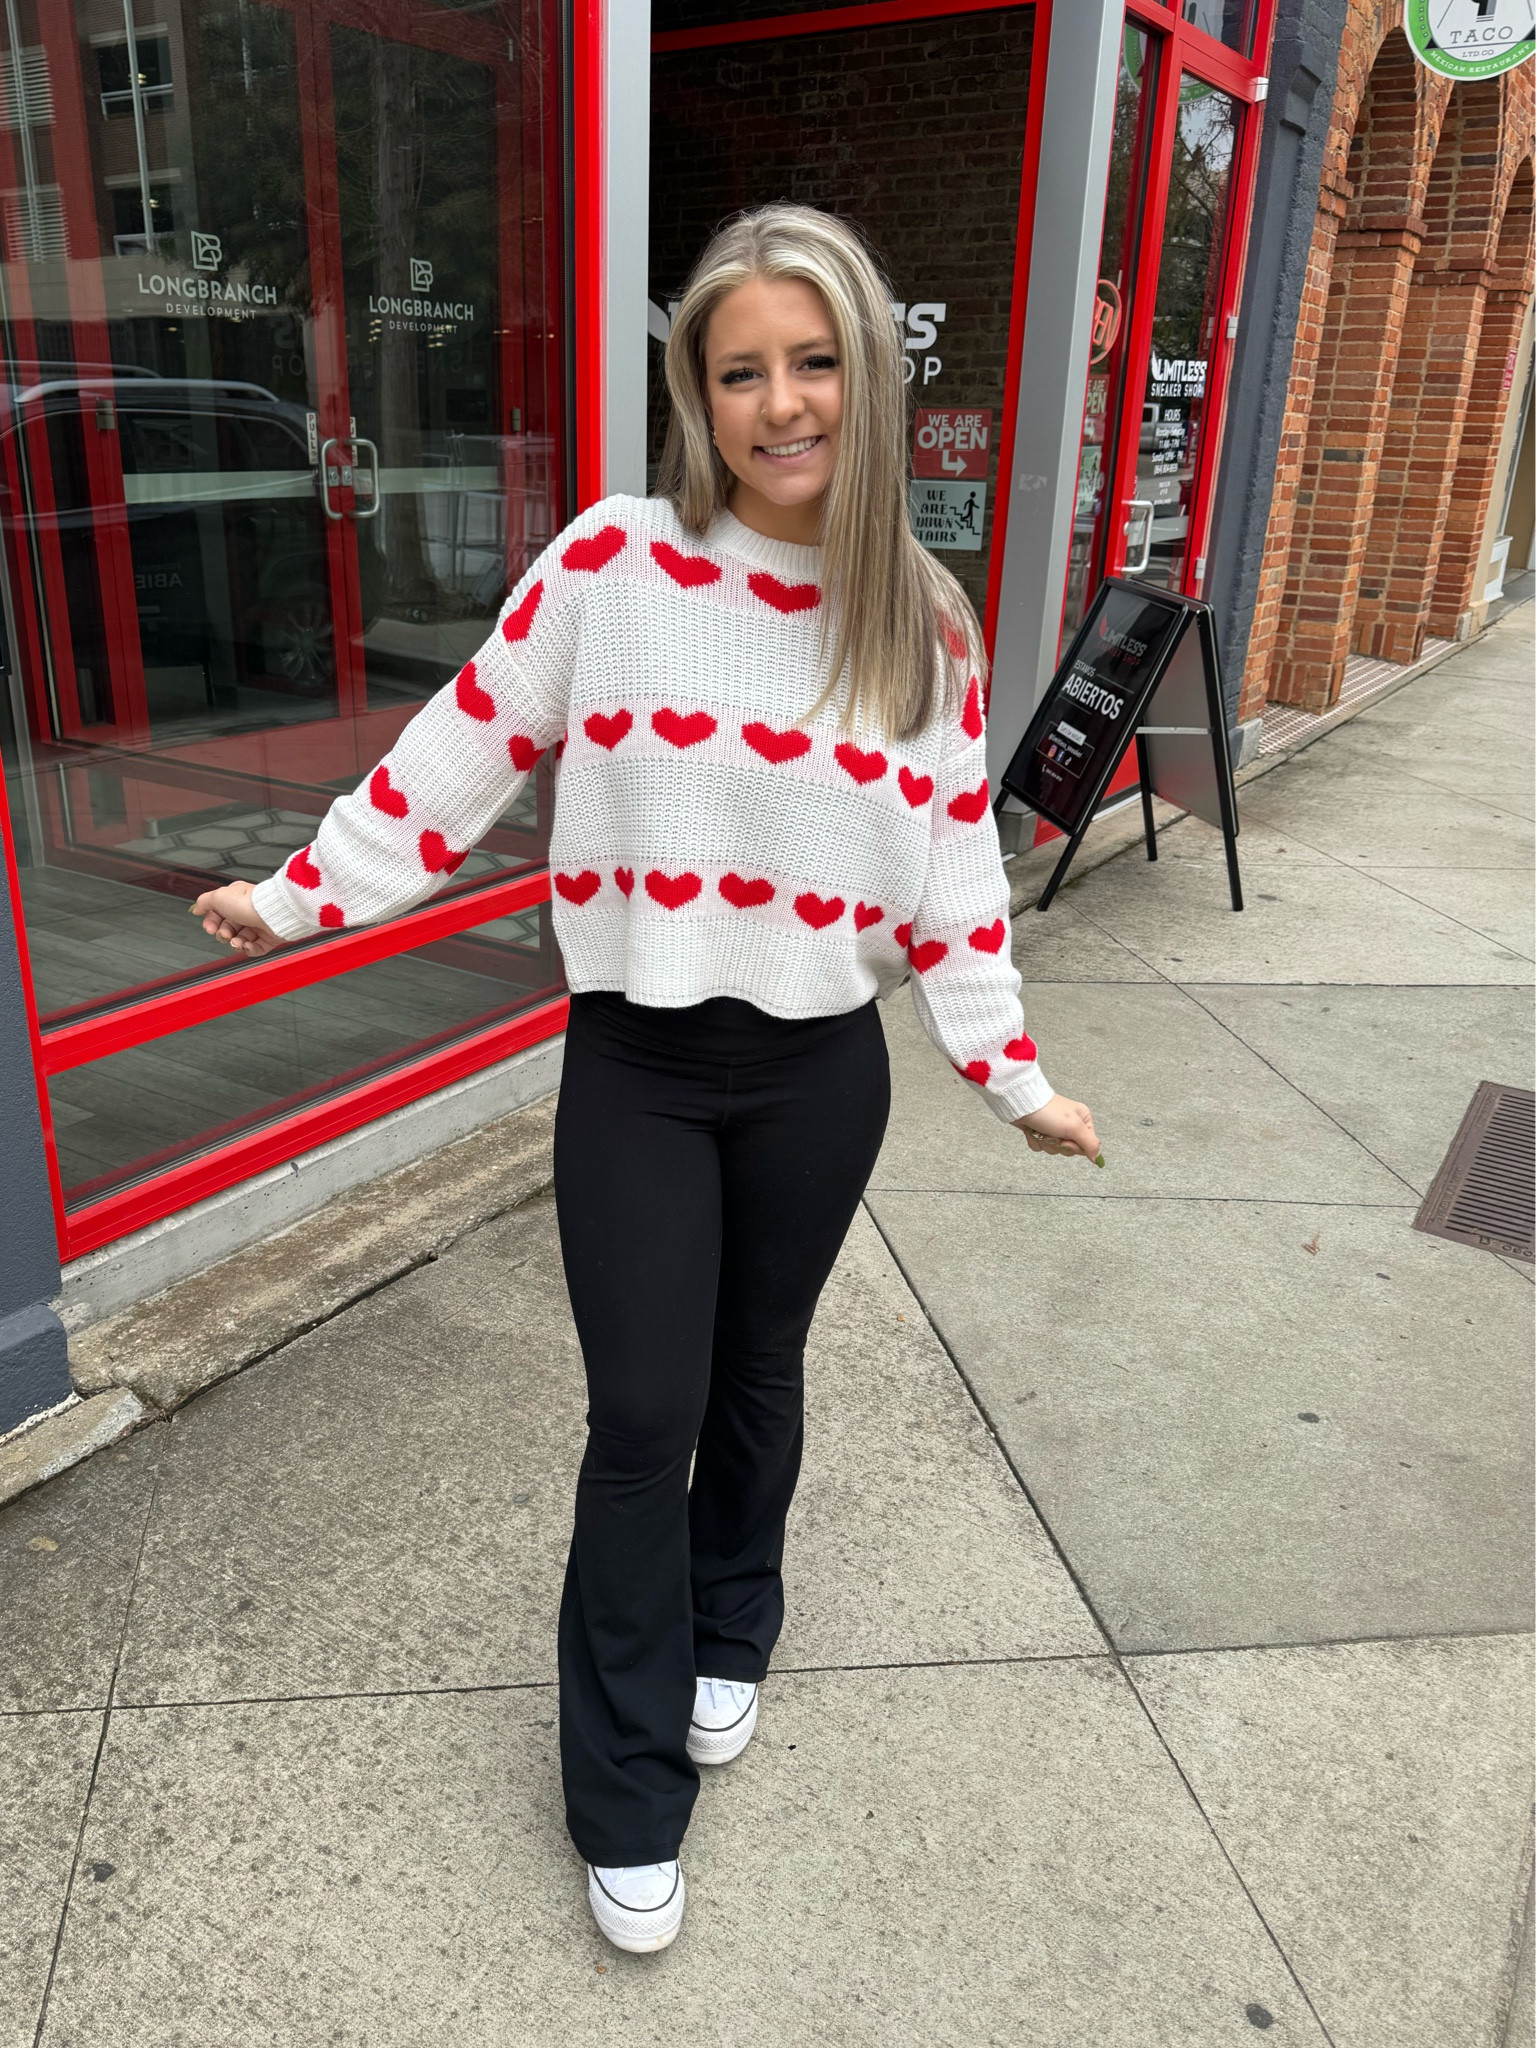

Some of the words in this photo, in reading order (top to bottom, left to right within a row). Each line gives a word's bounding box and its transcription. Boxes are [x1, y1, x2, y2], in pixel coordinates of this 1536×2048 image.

[1450, 26, 1513, 44] TACO
[1430, 51, 1466, 72] MEXICAN
[1469, 44, 1531, 73] RESTAURANT
[138, 273, 278, 305] LONGBRANCH
[166, 303, 257, 320] DEVELOPMENT
[368, 295, 474, 321] LONGBRANCH
[389, 320, 458, 334] DEVELOPMENT
[1152, 357, 1208, 382] LIMITLESS
[1151, 383, 1182, 397] SNEAKER
[1184, 384, 1202, 397] SHOP
[1086, 392, 1107, 414] PEN
[928, 414, 950, 427] WE
[954, 414, 983, 427] ARE
[1164, 408, 1182, 422] HOURS
[308, 414, 316, 449] PULL
[917, 426, 988, 450] OPEN
[927, 489, 947, 501] WE
[920, 503, 948, 515] ARE
[916, 517, 954, 529] DOWN
[914, 530, 957, 543] TAIRS
[1102, 627, 1148, 657] LIMITLESS
[1061, 673, 1124, 720] ABIERTOS
